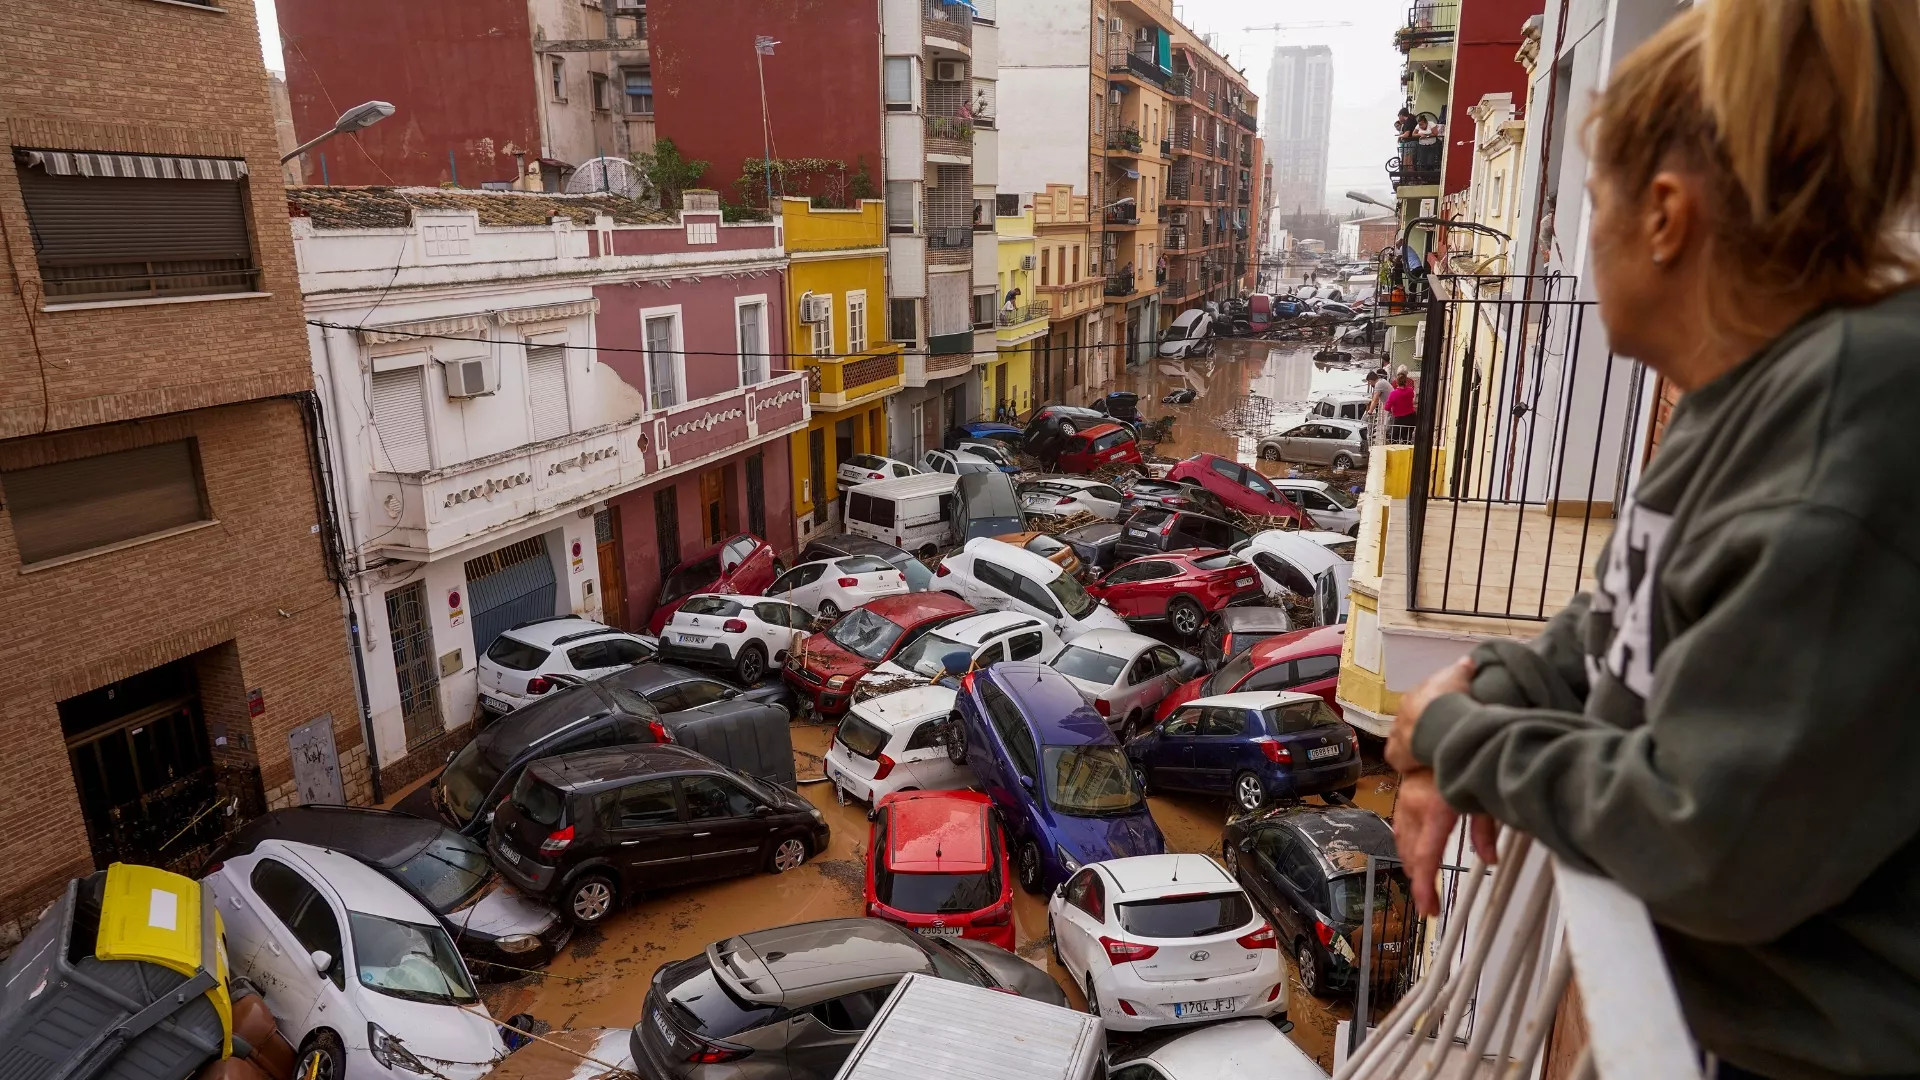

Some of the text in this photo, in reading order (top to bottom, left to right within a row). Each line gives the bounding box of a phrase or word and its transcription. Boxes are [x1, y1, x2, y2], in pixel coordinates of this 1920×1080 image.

[921, 927, 960, 935] 2305 LJV
[1183, 999, 1231, 1014] 1704 JFJ
